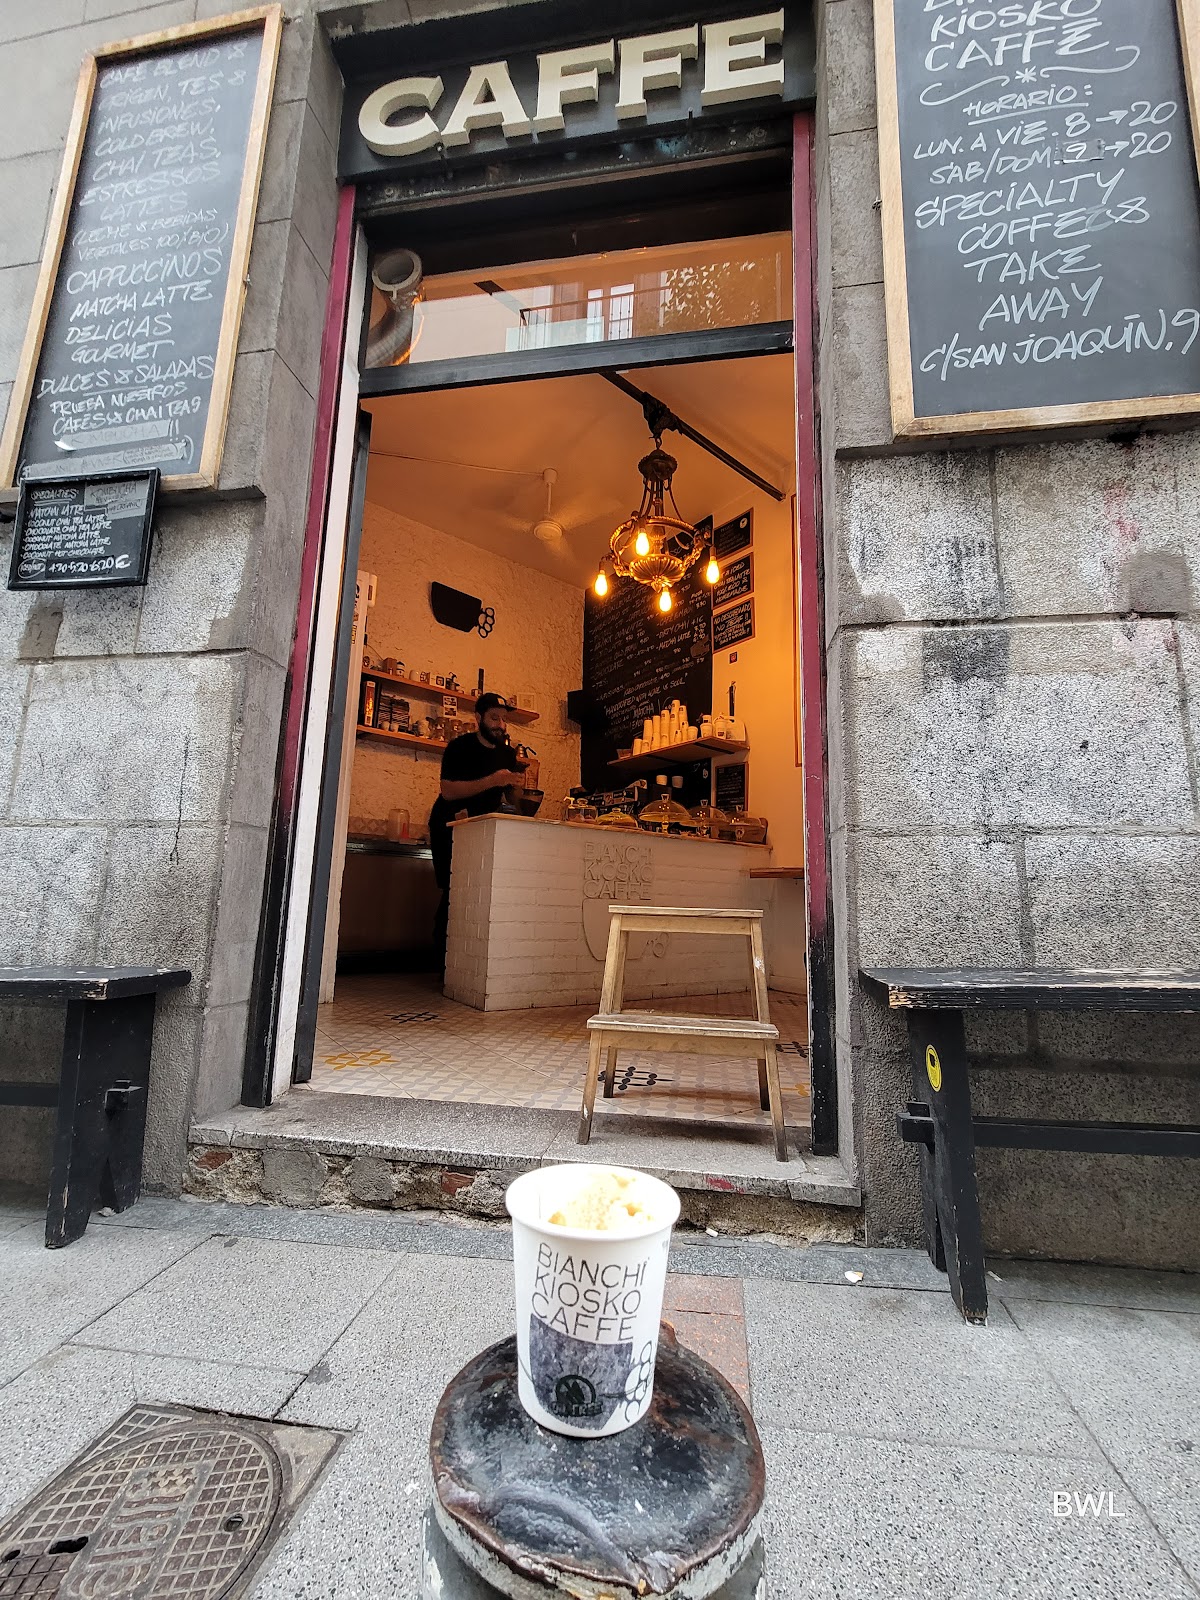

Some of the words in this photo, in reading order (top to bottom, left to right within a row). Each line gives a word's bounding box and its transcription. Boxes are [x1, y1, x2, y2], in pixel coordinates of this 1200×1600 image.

[358, 7, 786, 157] CAFFE
[95, 135, 145, 157] COLD
[913, 135, 963, 159] LUN.
[970, 133, 988, 152] A
[1065, 112, 1090, 137] 8
[1128, 101, 1177, 127] 20
[1065, 142, 1088, 160] 9
[1129, 131, 1172, 158] 20
[79, 161, 221, 207] ESPRESSOS
[93, 150, 146, 182] CHAI
[100, 190, 189, 222] LATTES
[151, 208, 217, 231] BEBIDAS
[915, 168, 1125, 229] SPECIALTY
[66, 248, 222, 295] CAPPUCCINOS
[963, 244, 1102, 285] TAKE
[70, 290, 137, 322] MATCHA
[142, 279, 213, 308] LATTE
[978, 276, 1103, 331] AWAY
[64, 312, 173, 346] DELICIAS
[70, 340, 175, 364] GOURMET
[37, 371, 111, 399] DULCES
[134, 354, 214, 382] SALADAS
[50, 393, 105, 417] PRUEBA
[110, 381, 188, 405] NUESTROS
[125, 402, 163, 424] CHAI
[583, 880, 652, 900] CAFFE
[537, 1242, 650, 1288] BIANCHI
[534, 1267, 641, 1315] KIOSKO
[531, 1292, 637, 1341] CAFFE
